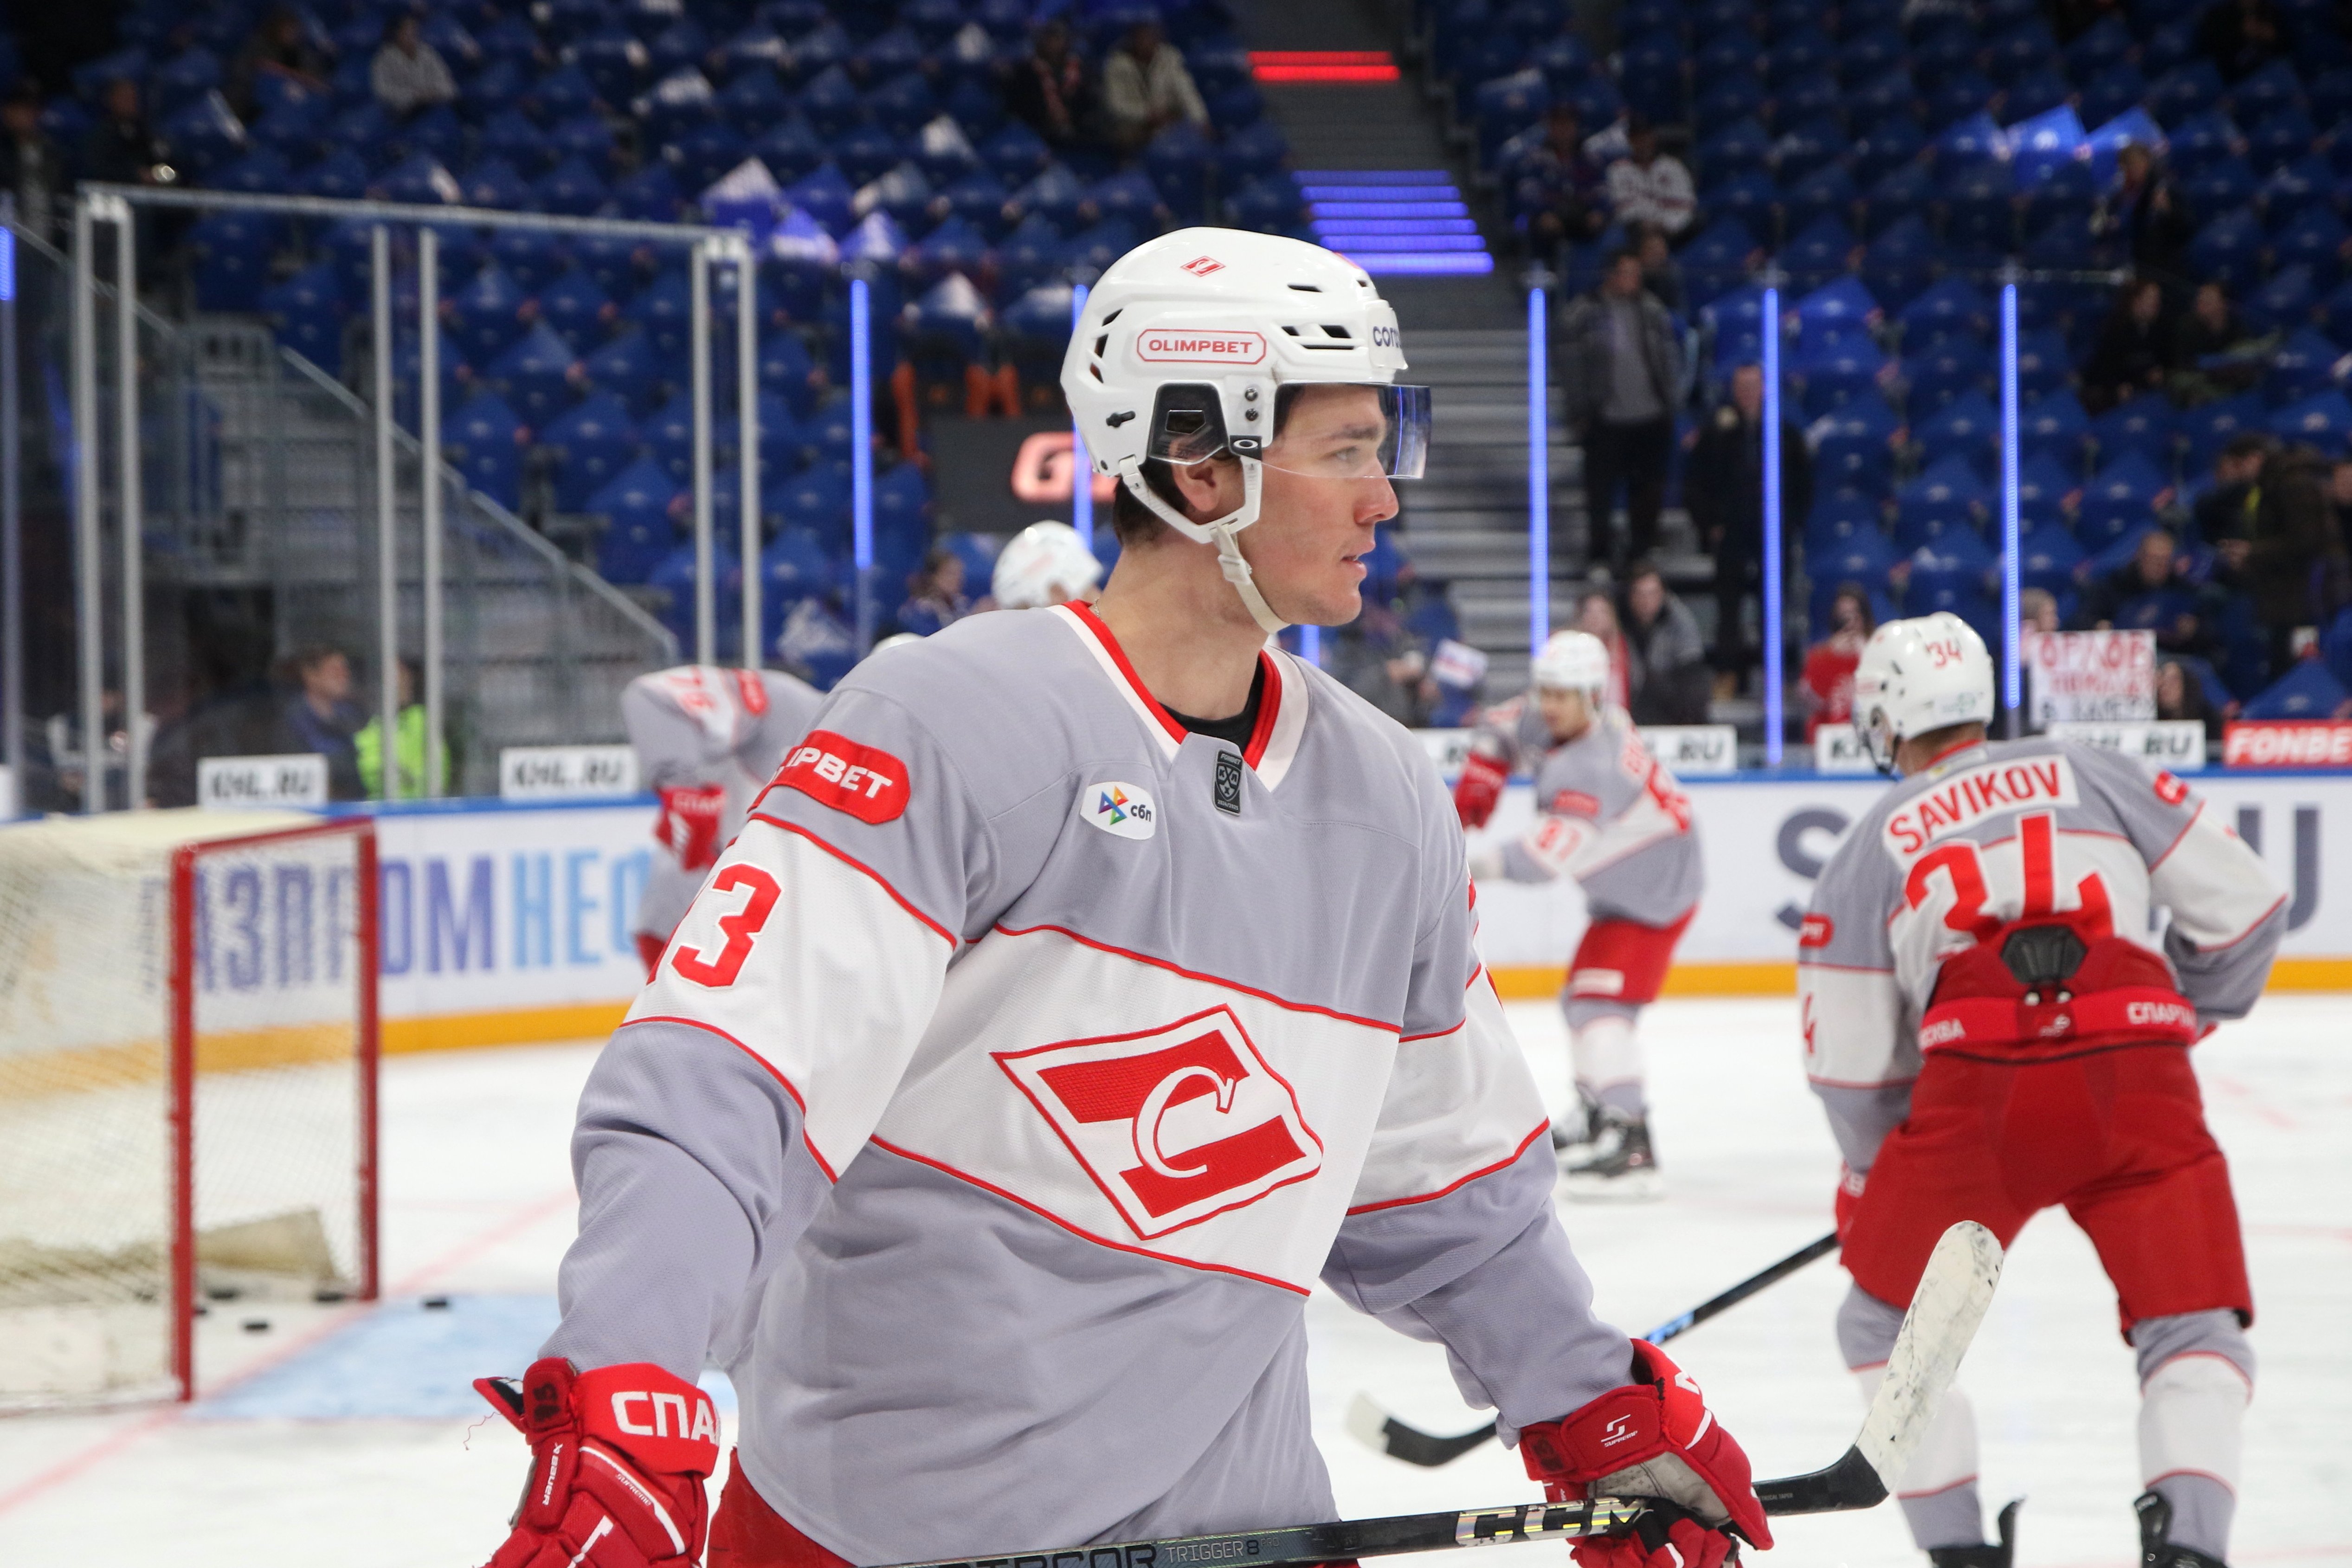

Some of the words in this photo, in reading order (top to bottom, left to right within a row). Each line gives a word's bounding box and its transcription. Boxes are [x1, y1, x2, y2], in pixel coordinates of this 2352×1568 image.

[1148, 338, 1253, 354] OLIMPBET
[1927, 639, 1964, 668] 34
[2227, 727, 2352, 764] FONBE
[779, 746, 893, 799] PBET
[1130, 804, 1152, 822] сбп
[1890, 761, 2061, 854] SAVIKOV
[650, 862, 783, 990] 3
[611, 1391, 721, 1447] СПА
[615, 1473, 651, 1506] SUPREME
[1165, 1541, 1244, 1563] TRIGGER
[1261, 1537, 1280, 1547] PRO
